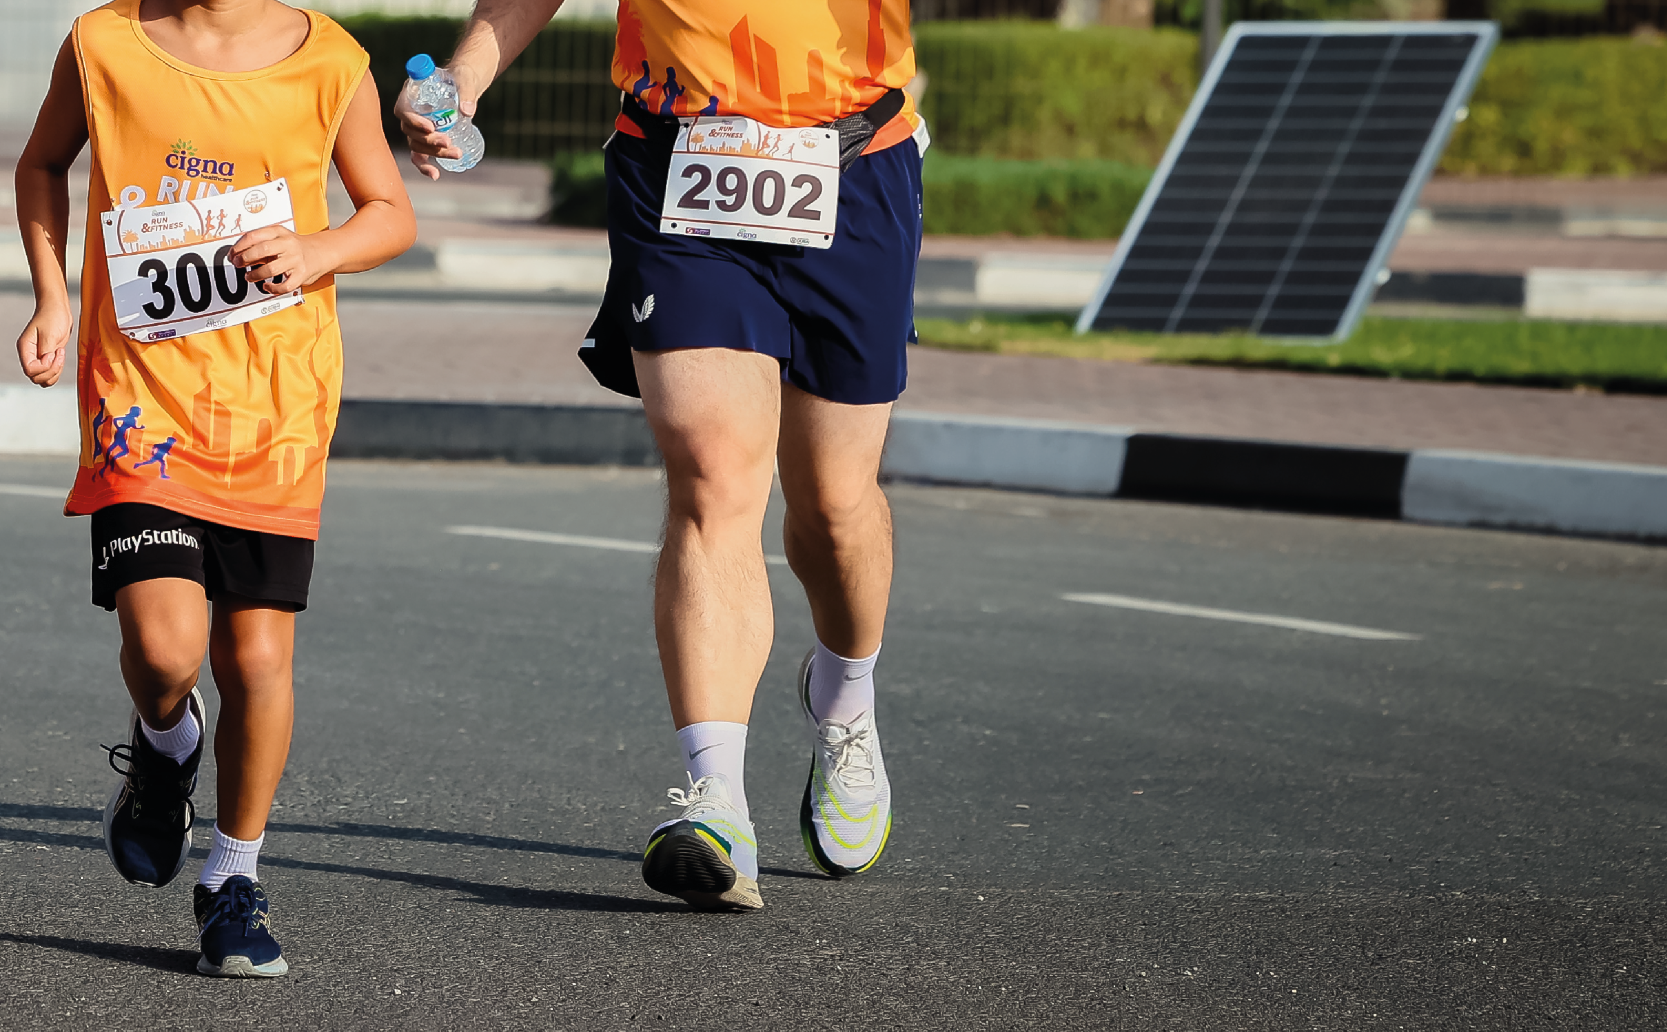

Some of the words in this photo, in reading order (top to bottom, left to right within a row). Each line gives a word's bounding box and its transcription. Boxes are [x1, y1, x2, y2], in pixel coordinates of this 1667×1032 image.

[165, 150, 235, 178] cigna
[676, 163, 823, 221] 2902
[150, 217, 169, 225] RUN
[137, 244, 284, 321] 300
[109, 528, 200, 558] PlayStation
